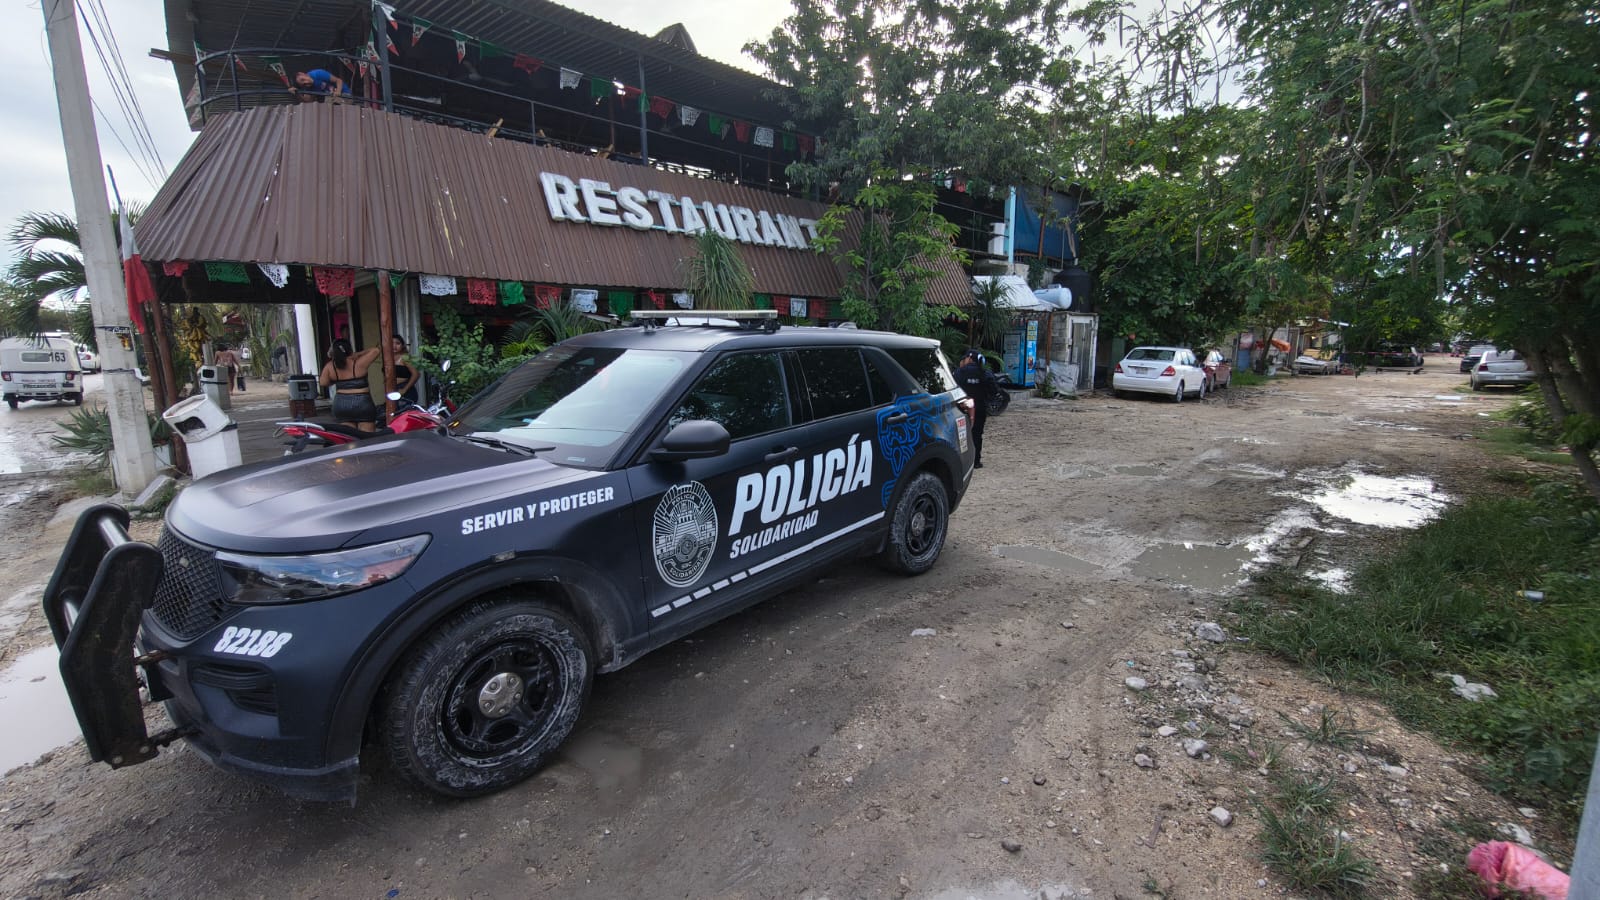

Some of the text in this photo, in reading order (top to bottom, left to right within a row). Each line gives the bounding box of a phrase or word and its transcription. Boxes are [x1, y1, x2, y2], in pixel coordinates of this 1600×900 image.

[540, 171, 825, 252] RESTAURANT
[48, 352, 66, 362] 163
[728, 433, 873, 536] POLICÍA
[461, 486, 614, 535] SERVIR Y PROTEGER
[730, 509, 819, 559] SOLIDARIDAD
[213, 625, 293, 658] 82188
